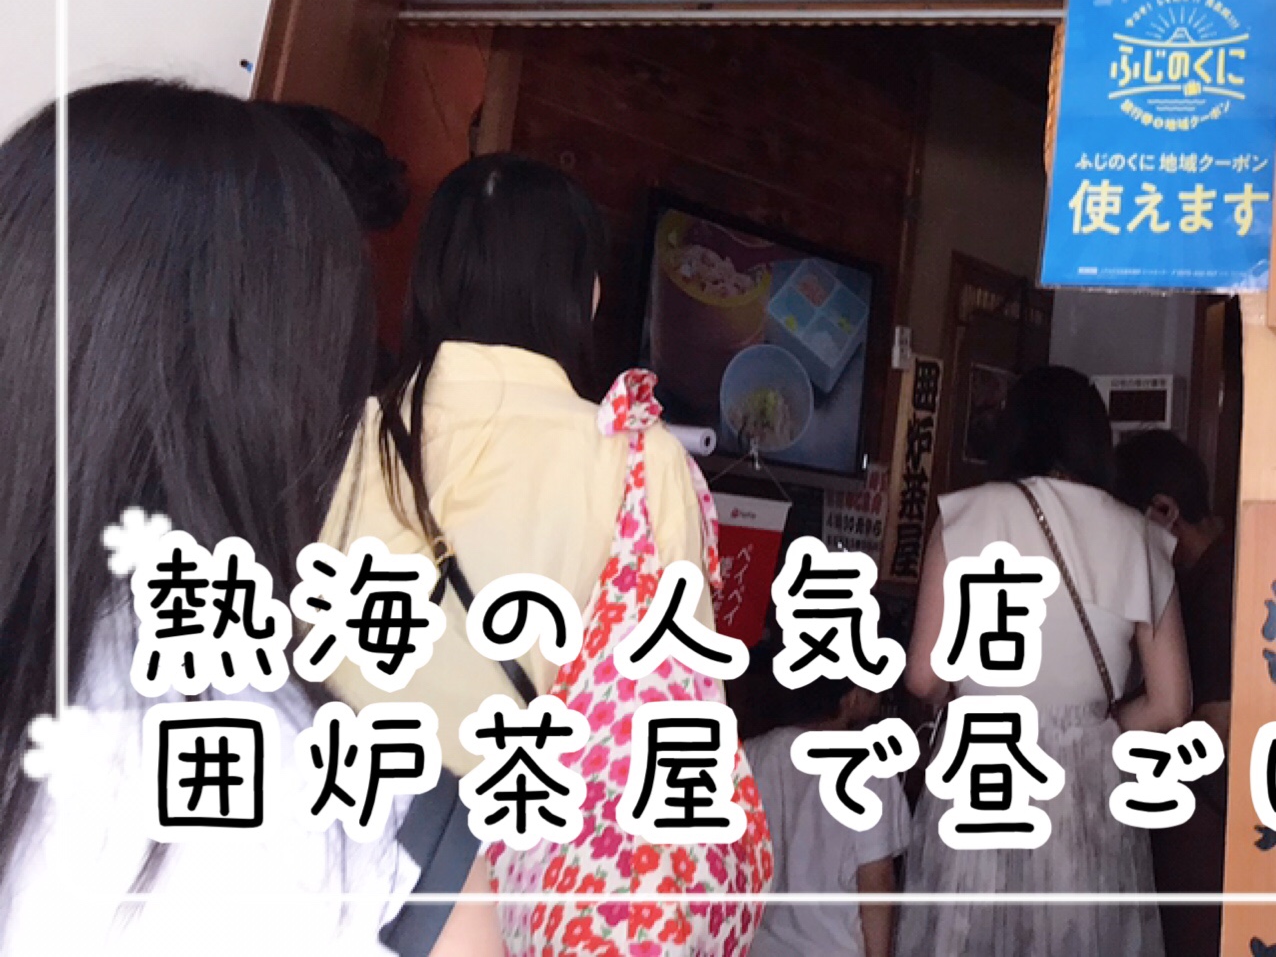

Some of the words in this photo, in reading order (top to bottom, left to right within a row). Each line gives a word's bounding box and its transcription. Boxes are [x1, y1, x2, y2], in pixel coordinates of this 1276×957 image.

[1109, 44, 1246, 88] ふじのくに
[1075, 152, 1156, 172] ふじのくに
[1158, 152, 1269, 173] 地域クーポン
[1068, 178, 1270, 237] 使えます
